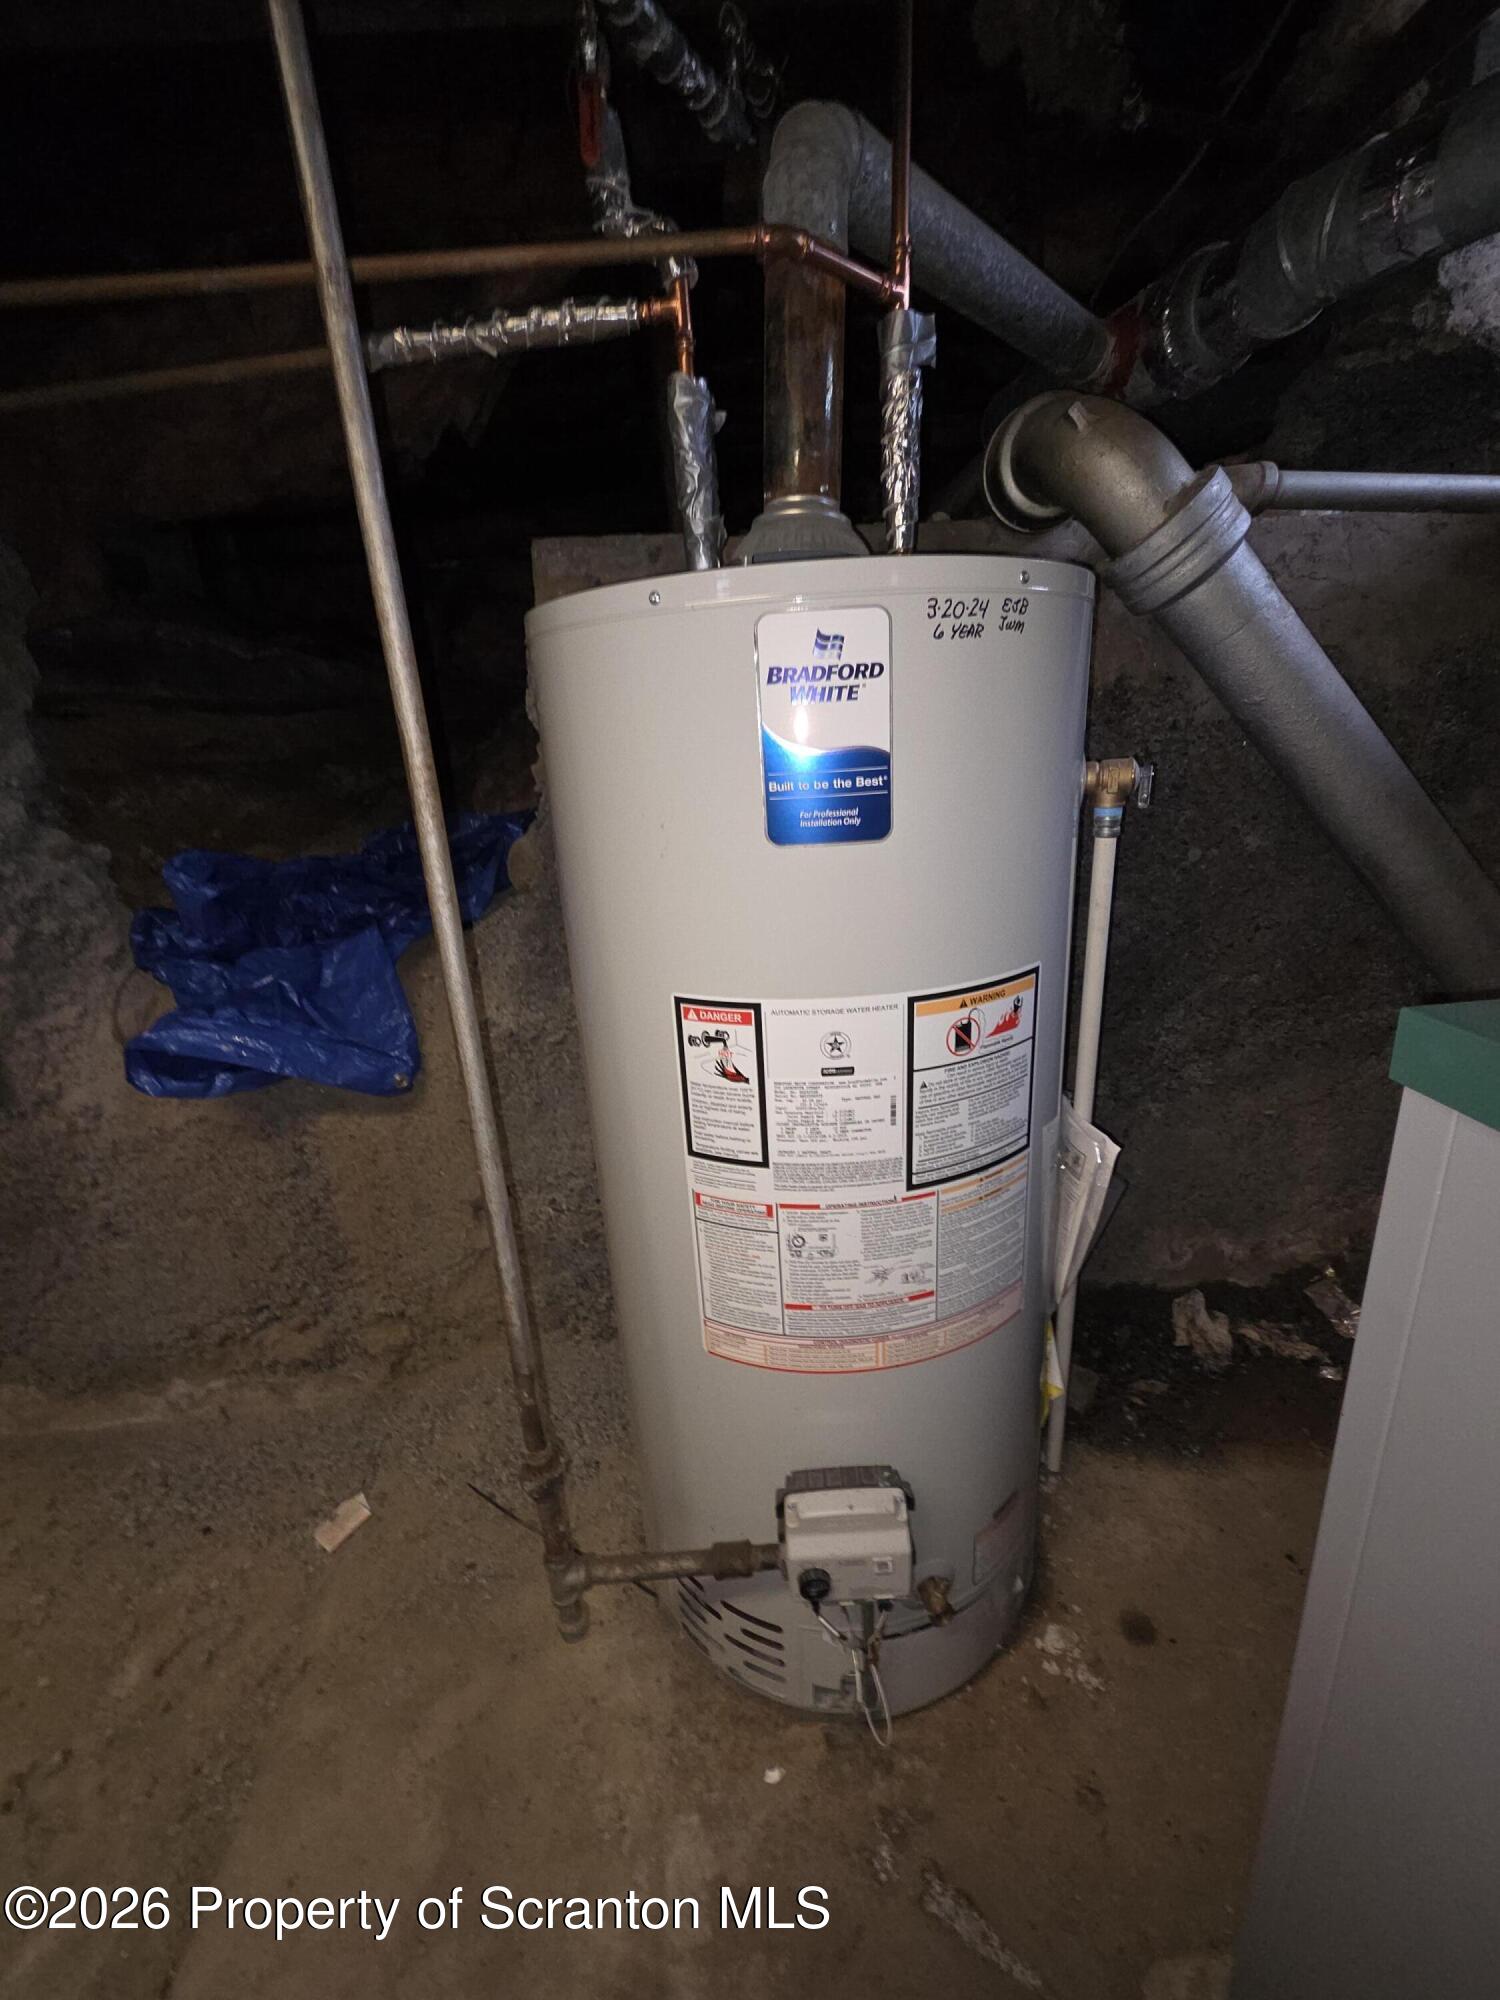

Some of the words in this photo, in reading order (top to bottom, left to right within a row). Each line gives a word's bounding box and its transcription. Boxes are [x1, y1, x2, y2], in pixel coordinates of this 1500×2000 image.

[933, 622, 945, 640] 6
[950, 622, 985, 640] YEAR
[766, 662, 885, 685] BRADFORD
[789, 684, 860, 705] WHITE
[768, 781, 794, 792] Built
[798, 780, 809, 791] to
[813, 780, 829, 790] be
[833, 778, 852, 789] the
[800, 810, 812, 819] For
[813, 806, 859, 819] Professional
[800, 817, 842, 828] Installation
[843, 816, 861, 827] Only
[969, 989, 1006, 1005] WARNING
[699, 1010, 743, 1023] DANGER
[771, 1008, 810, 1017] AUTOMATIC
[812, 1008, 844, 1016] STORAGE
[846, 1006, 870, 1014] WATER
[872, 1003, 899, 1012] HEATER
